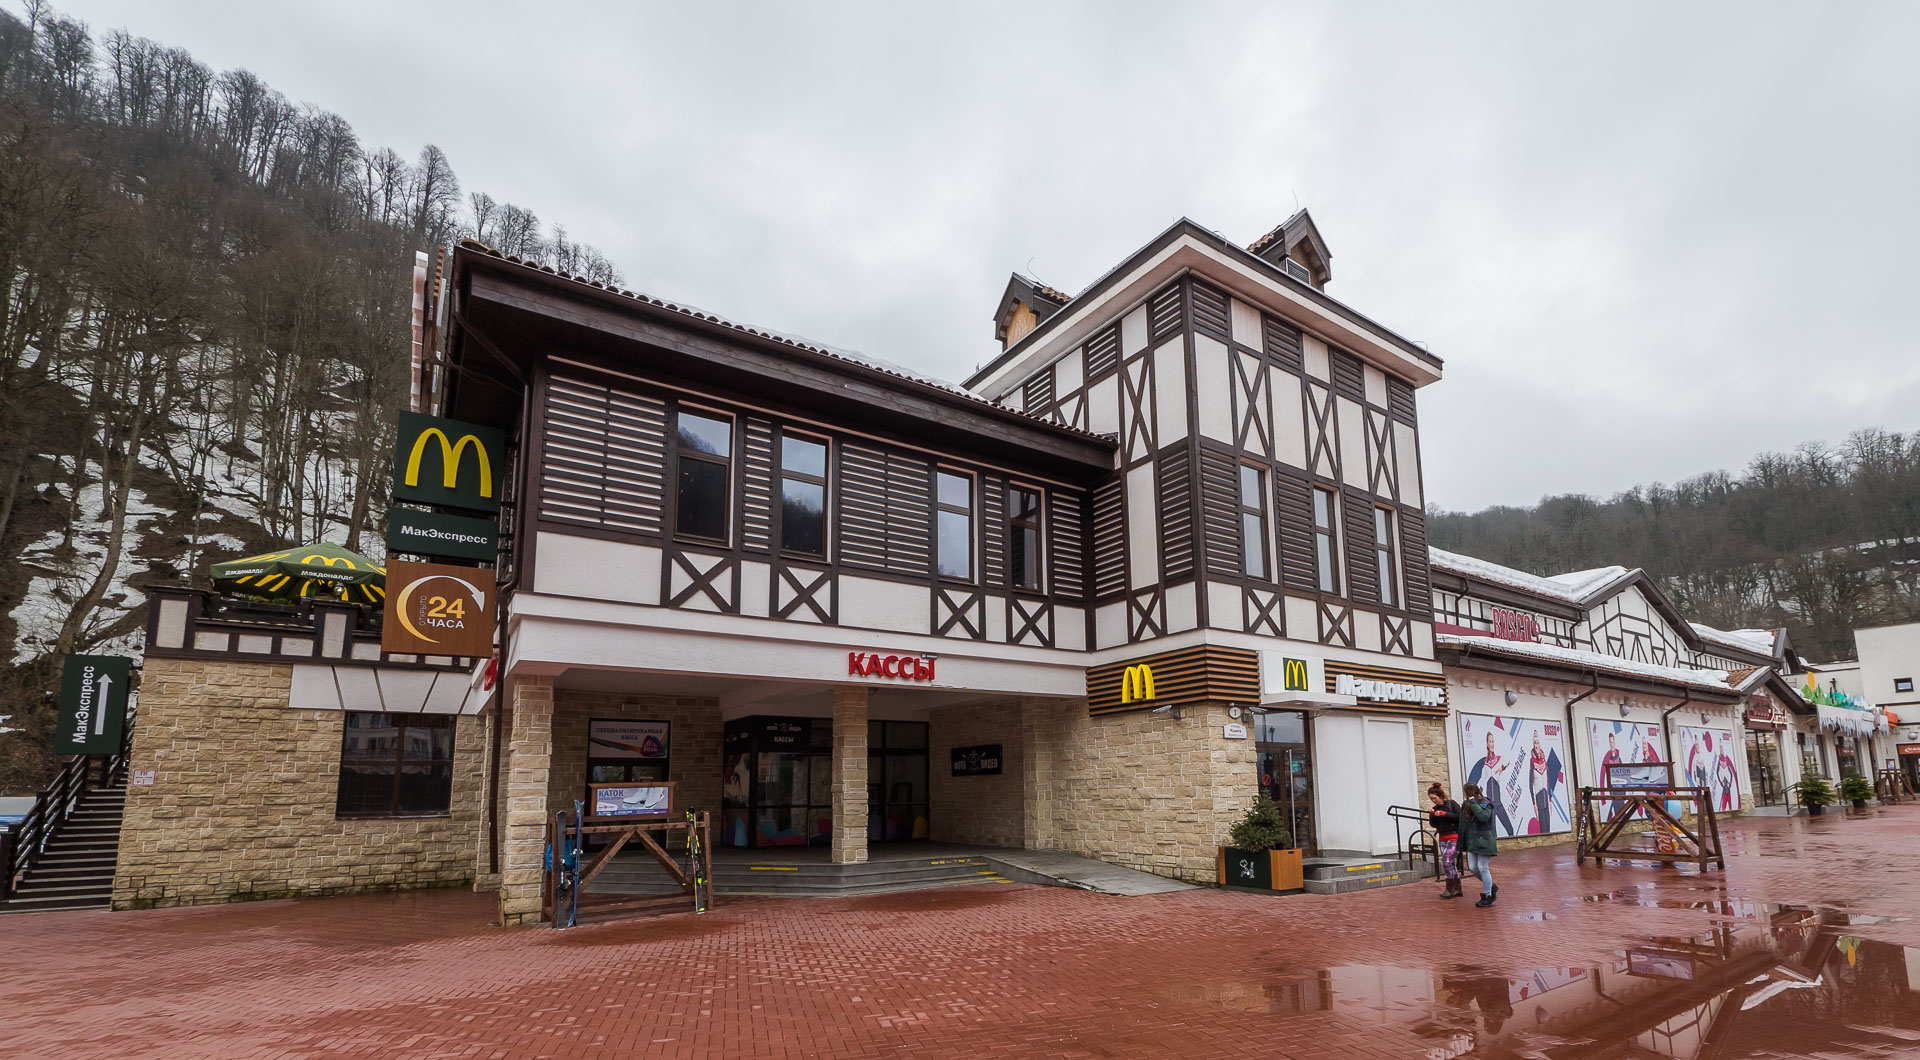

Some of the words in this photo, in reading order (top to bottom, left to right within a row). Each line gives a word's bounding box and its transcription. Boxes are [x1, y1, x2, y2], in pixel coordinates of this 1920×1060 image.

[400, 525, 488, 544] МакЭкспресс
[427, 596, 465, 619] 24
[427, 618, 465, 629] ЧАСА
[1492, 607, 1533, 643] BOSCO
[848, 652, 935, 681] КАССЫ
[1336, 674, 1445, 706] Макдоналдс
[72, 666, 95, 744] МакЭкспресс
[599, 789, 624, 797] КАТОК
